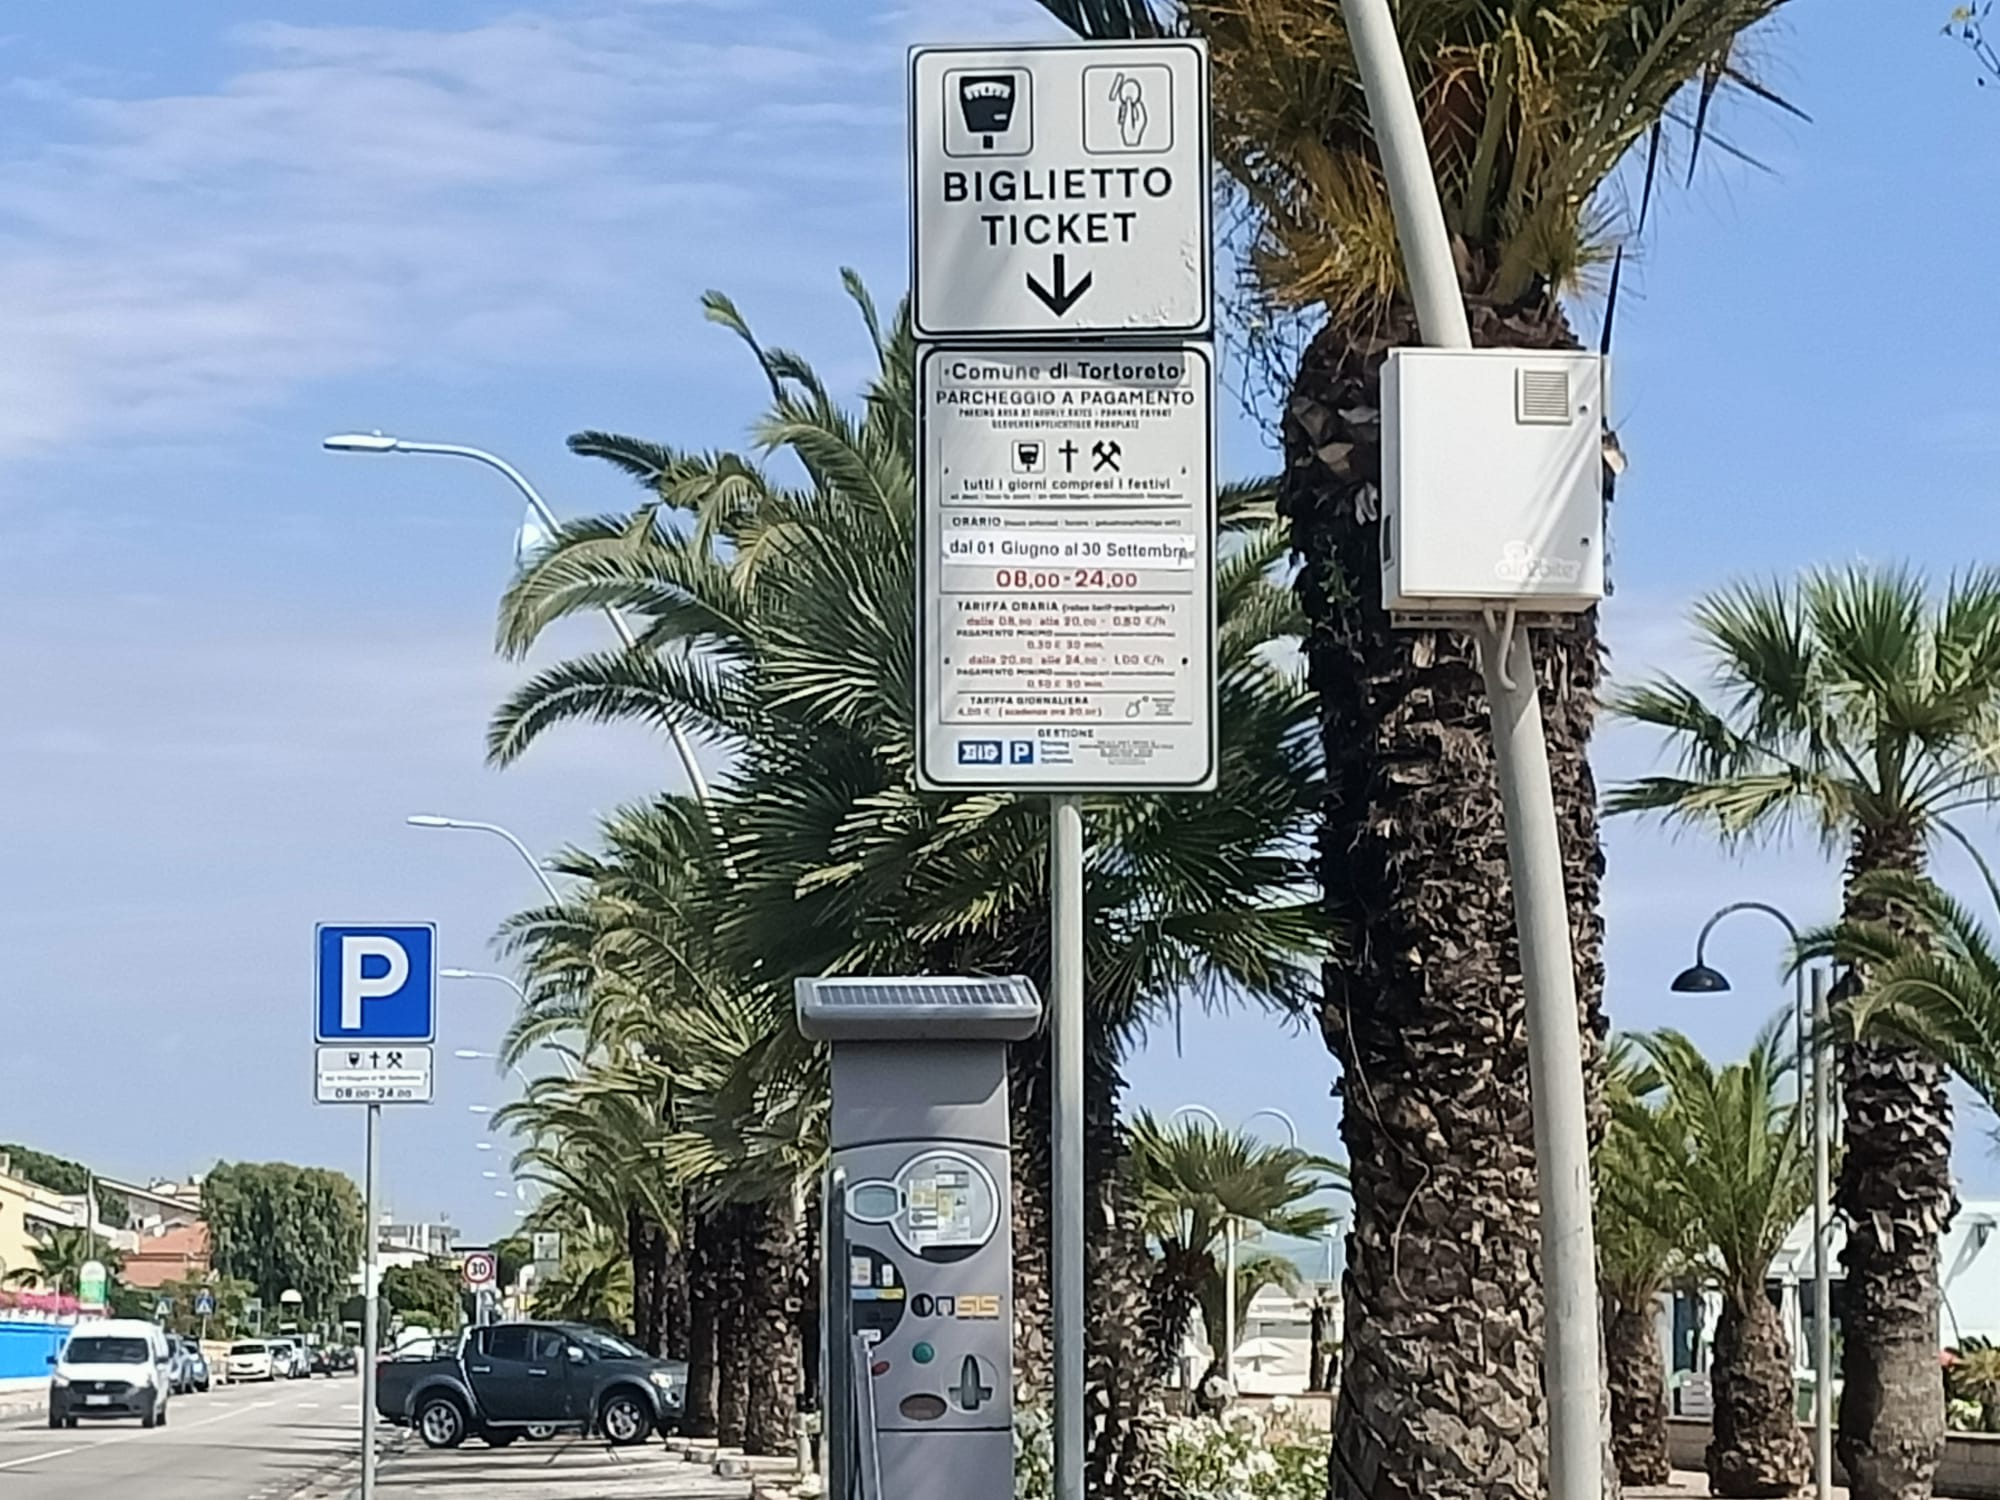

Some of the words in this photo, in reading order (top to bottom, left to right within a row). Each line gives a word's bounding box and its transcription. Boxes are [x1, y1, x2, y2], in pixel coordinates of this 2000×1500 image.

[944, 167, 1172, 202] BIGLIETTO
[981, 212, 1136, 245] TICKET
[951, 362, 1041, 380] Comune
[1049, 361, 1068, 379] di
[1078, 361, 1179, 380] Tortoreto
[936, 390, 1055, 405] PARCHEGGIO
[1062, 391, 1074, 405] A
[1080, 390, 1194, 405] PAGAMENTO
[963, 478, 994, 490] tutti
[1008, 477, 1047, 492] giorni
[1052, 477, 1113, 491] compresi
[1128, 477, 1170, 490] festivi
[952, 517, 1001, 527] ORARIO
[950, 539, 972, 554] dal
[977, 541, 994, 554] 01
[1001, 540, 1059, 557] Giugno
[1064, 542, 1078, 556] al
[1083, 542, 1101, 556] 30
[957, 602, 1008, 611] TARIFFA
[341, 935, 409, 1029] P
[470, 1261, 487, 1275] 30
